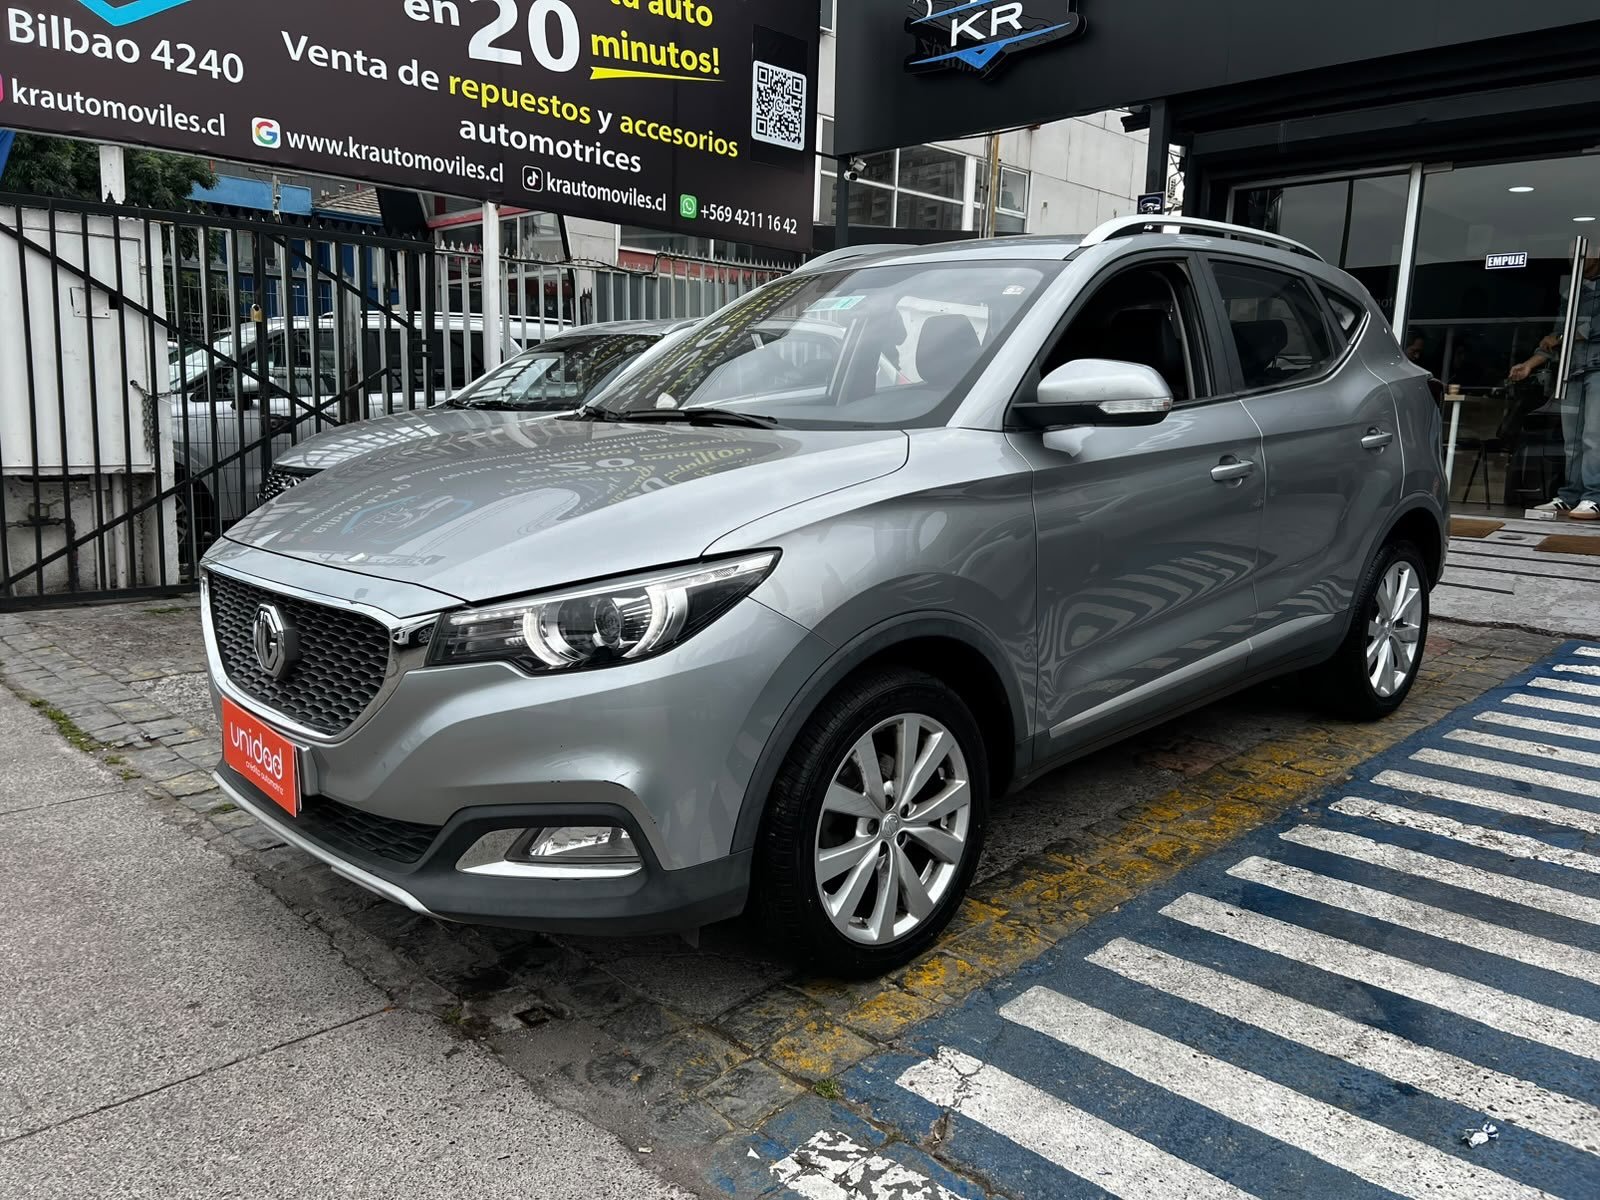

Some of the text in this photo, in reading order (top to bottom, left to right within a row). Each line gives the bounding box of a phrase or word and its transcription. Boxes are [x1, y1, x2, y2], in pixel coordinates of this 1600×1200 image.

[403, 0, 580, 73] en 20
[648, 0, 713, 27] auto
[951, 2, 1023, 47] KR
[7, 7, 244, 83] Bilbao 4240
[590, 30, 720, 75] minutos!
[11, 77, 226, 137] krautomoviles.cl
[281, 31, 739, 158] Venta de repuestos y accesorios
[286, 131, 504, 183] www.krautomoviles.cl
[459, 119, 642, 173] automotrices
[546, 172, 667, 212] krautomoviles.cl
[700, 203, 797, 235] +569 4211 16 42
[1488, 254, 1525, 267] EMPUJE
[230, 721, 283, 780] unidad
